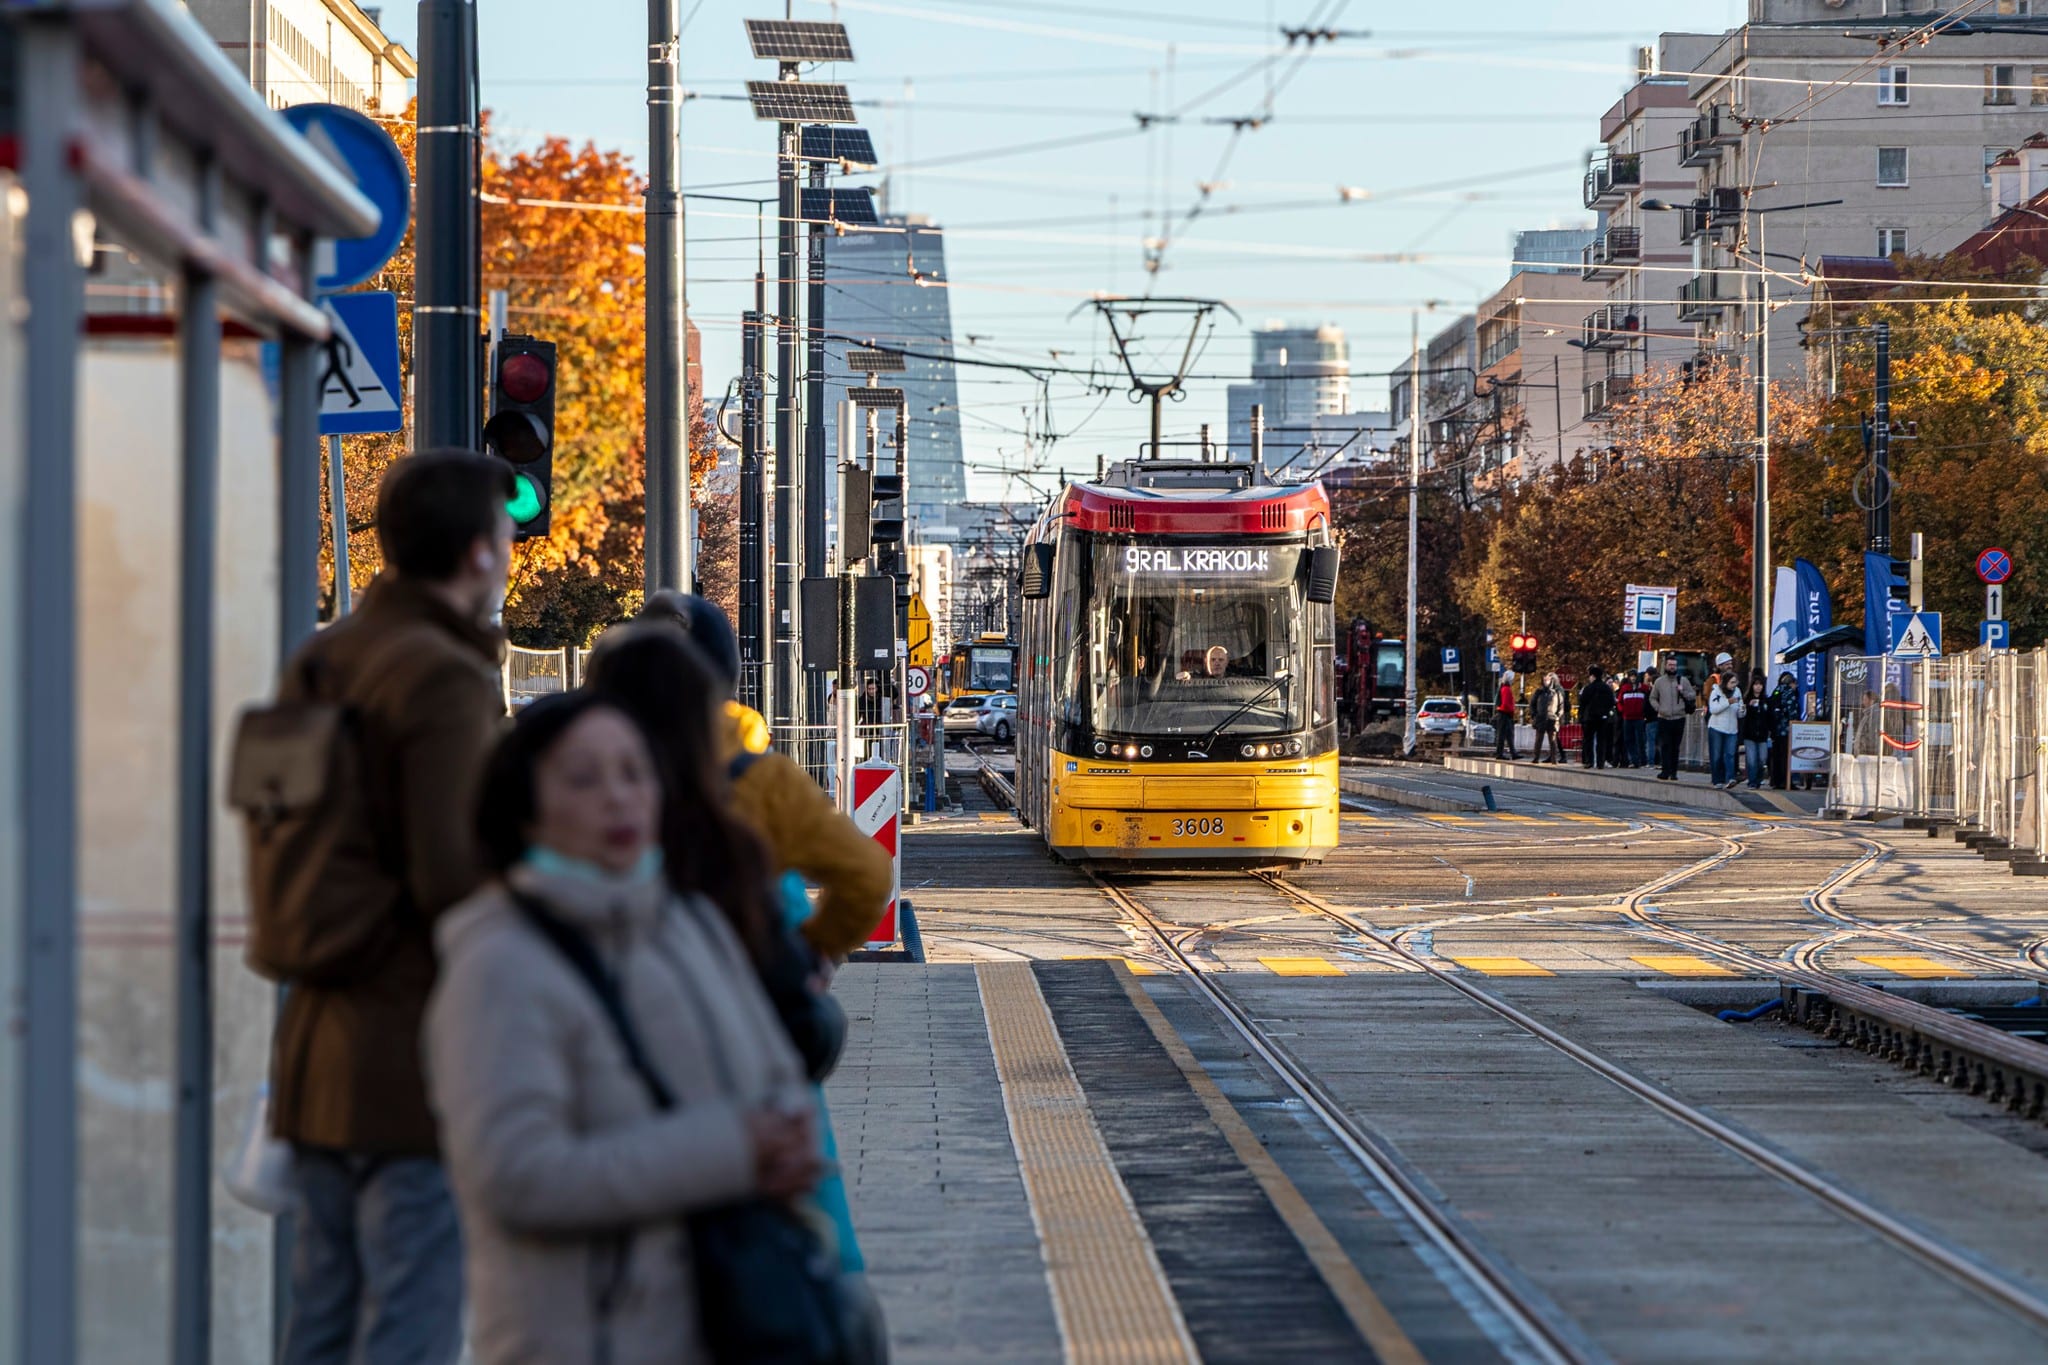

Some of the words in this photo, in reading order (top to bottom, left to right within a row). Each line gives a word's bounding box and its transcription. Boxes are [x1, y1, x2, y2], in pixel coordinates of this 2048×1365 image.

[1987, 624, 2003, 644] P
[1445, 649, 1456, 662] P
[1840, 660, 1861, 672] Bike
[1171, 817, 1225, 837] 3608
